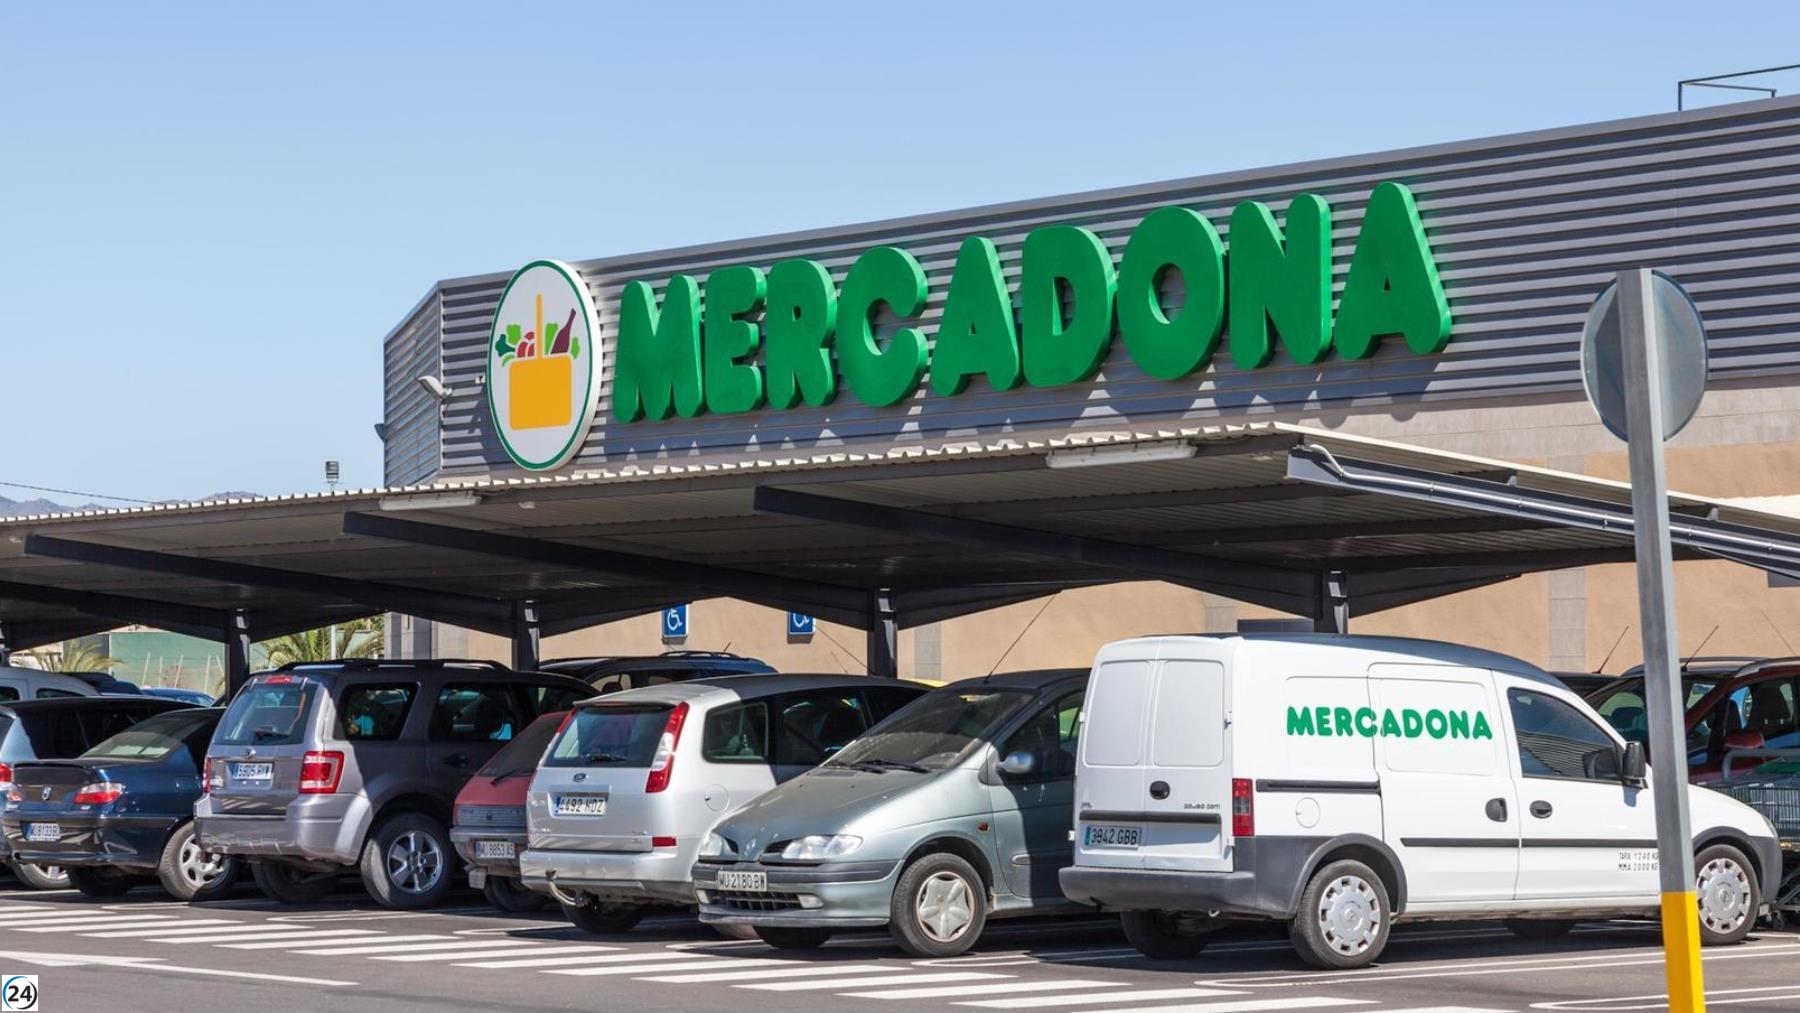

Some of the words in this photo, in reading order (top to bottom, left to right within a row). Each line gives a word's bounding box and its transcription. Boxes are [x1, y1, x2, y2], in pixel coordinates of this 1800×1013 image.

[613, 181, 1452, 424] MERCADONA
[1286, 705, 1493, 740] MERCADONA
[559, 798, 582, 812] 4492
[1091, 828, 1115, 844] 3942
[1117, 829, 1138, 846] GBB
